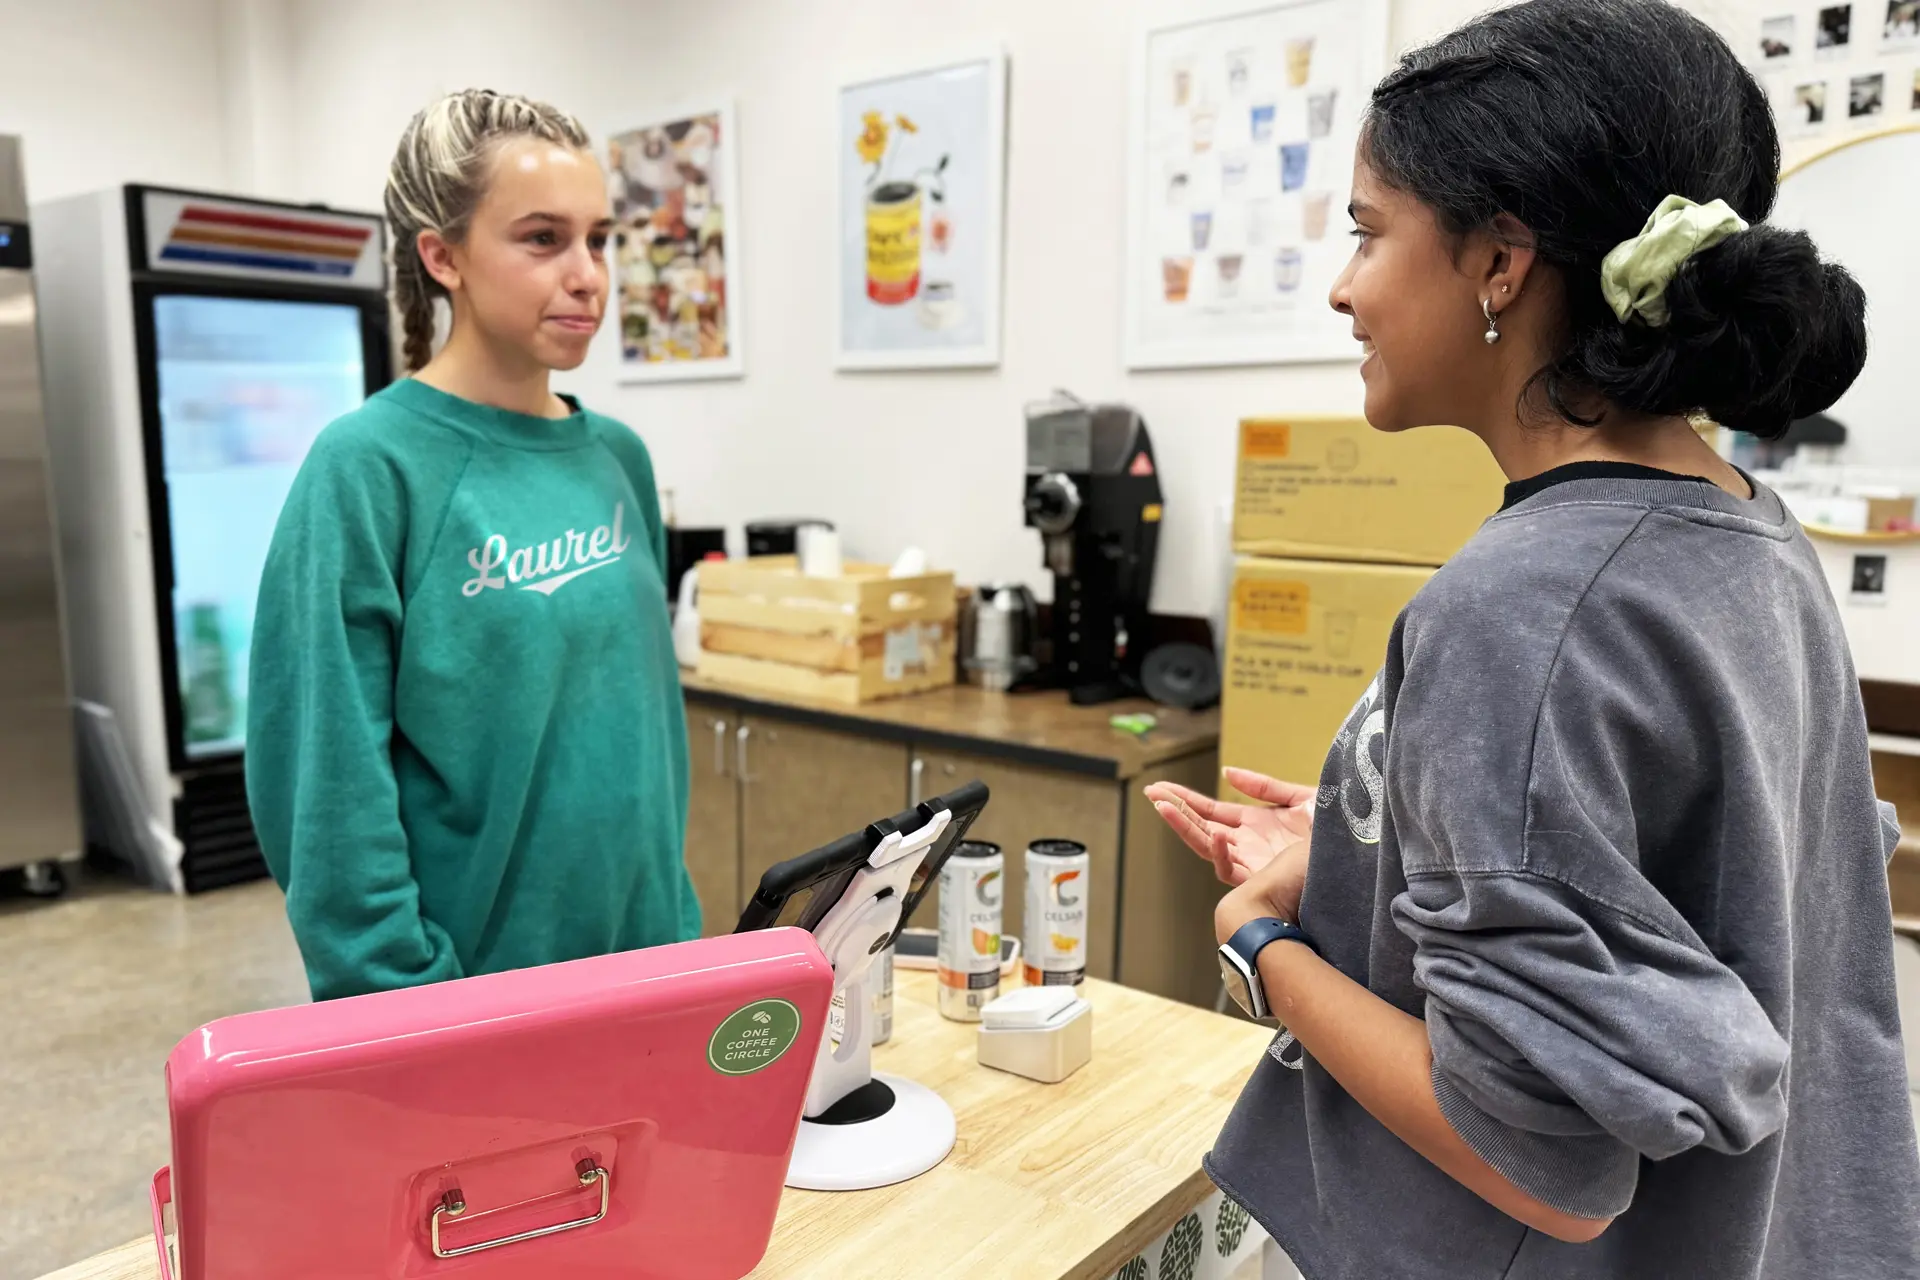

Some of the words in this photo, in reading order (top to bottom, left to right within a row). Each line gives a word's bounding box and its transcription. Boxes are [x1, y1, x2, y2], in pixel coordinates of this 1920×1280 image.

[462, 500, 631, 597] Laurel
[726, 1037, 778, 1050] COFFEE
[742, 1028, 770, 1038] ONE
[724, 1048, 771, 1060] CIRCLE
[1186, 1212, 1203, 1266] ONE
[1217, 1228, 1242, 1257] ONE
